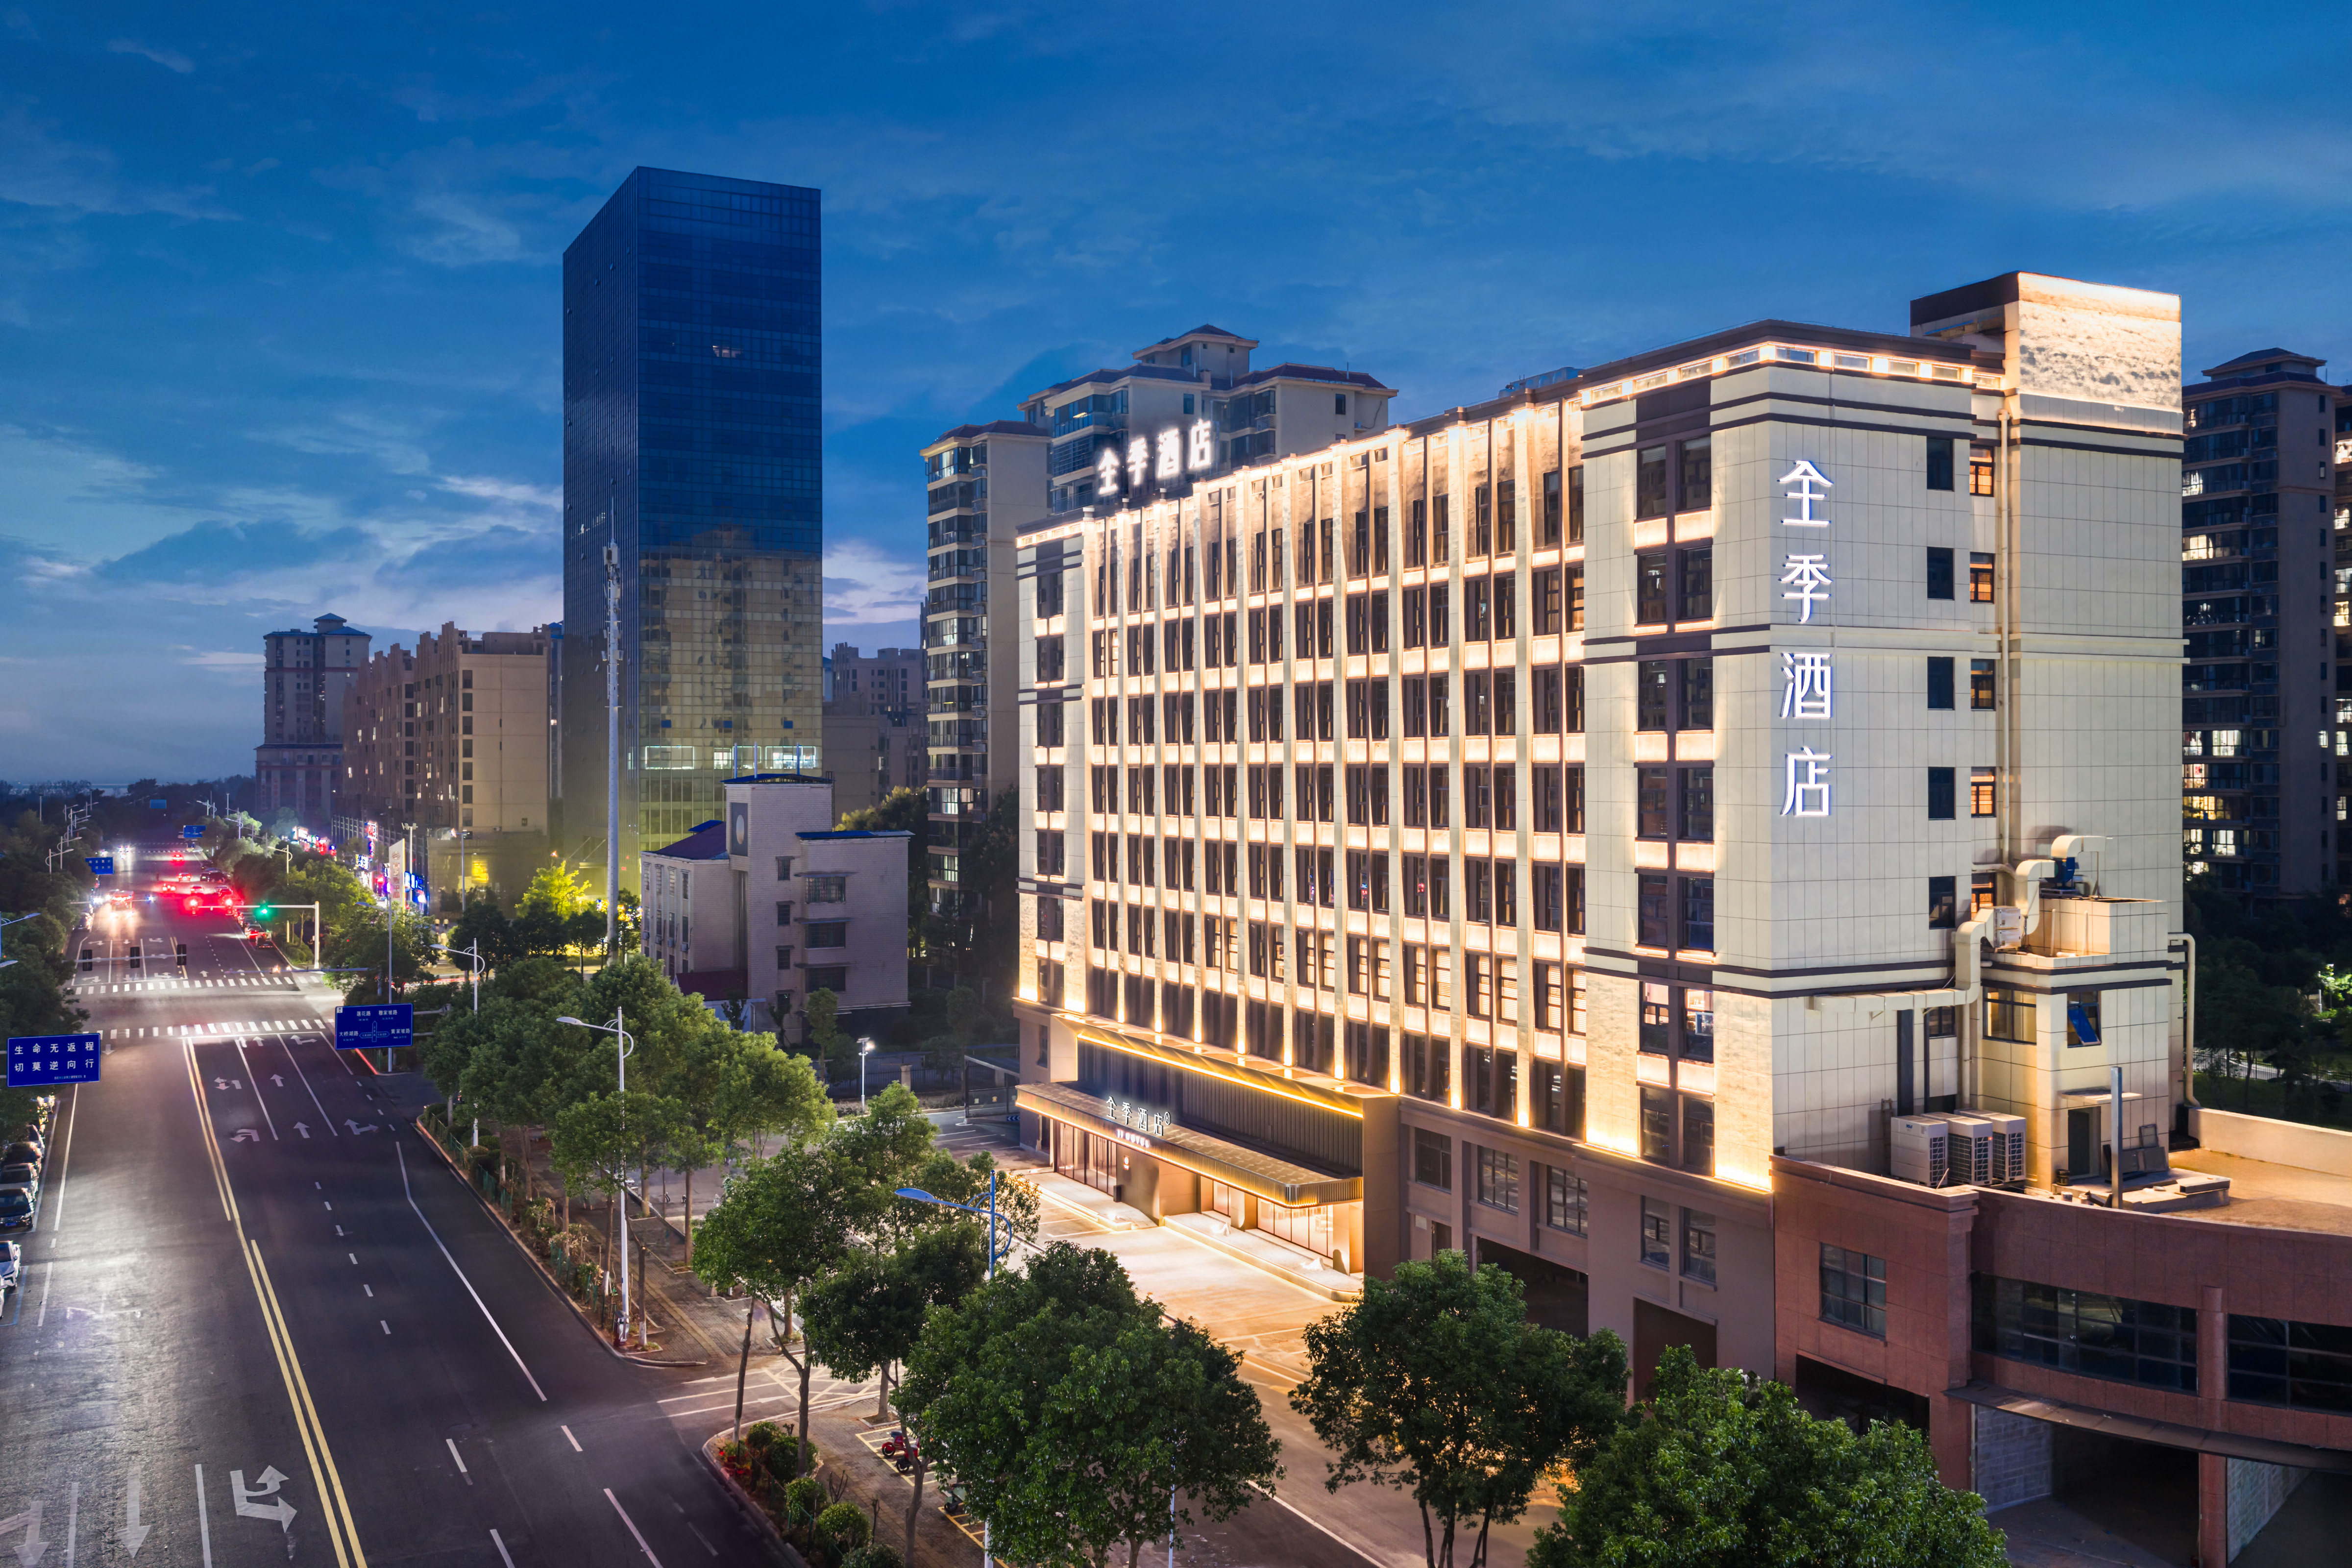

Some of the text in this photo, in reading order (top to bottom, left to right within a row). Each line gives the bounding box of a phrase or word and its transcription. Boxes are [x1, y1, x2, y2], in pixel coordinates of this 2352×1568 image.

[1098, 419, 1211, 495] 全季酒店
[1778, 460, 1833, 817] 全季酒店
[14, 1059, 94, 1072] 切莫逆向行
[15, 1042, 94, 1054] 生命无返程
[1106, 1096, 1164, 1136] 全季酒店
